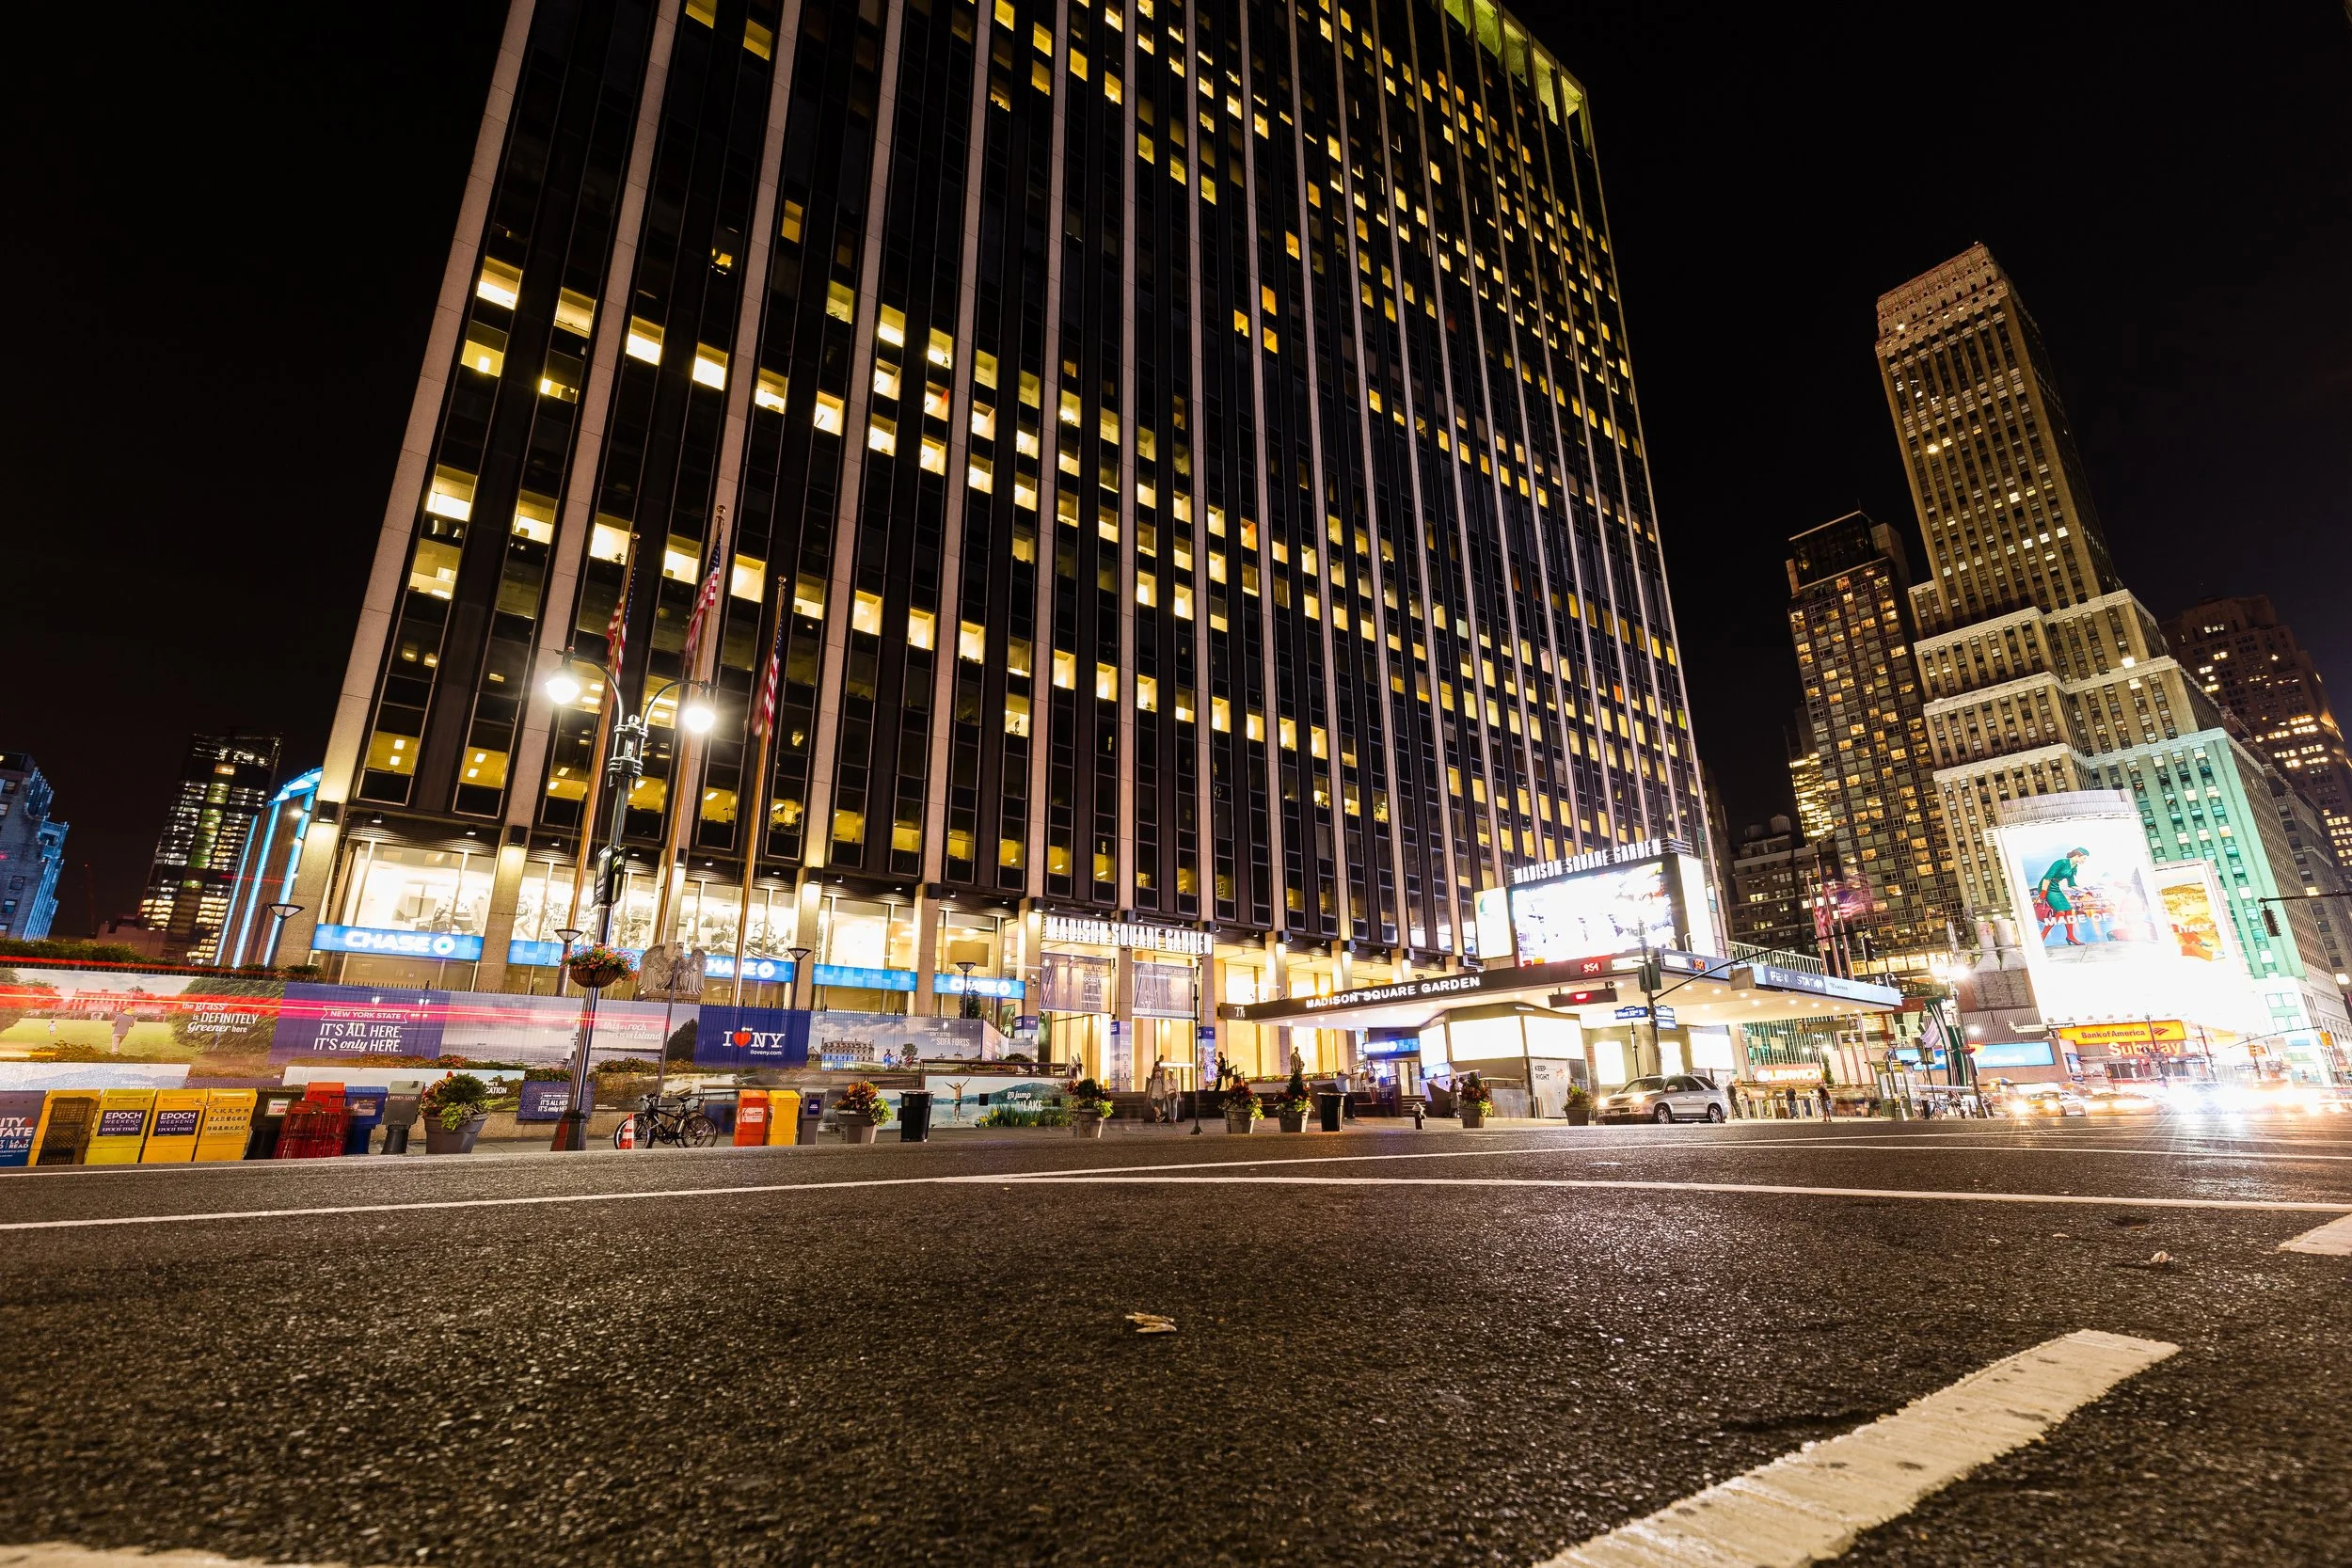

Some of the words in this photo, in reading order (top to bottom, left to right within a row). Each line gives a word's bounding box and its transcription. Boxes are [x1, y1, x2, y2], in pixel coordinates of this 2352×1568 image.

[1514, 860, 1563, 884] MADISON
[1565, 850, 1610, 873] SQUARE
[1613, 839, 1661, 863] GARDEN
[2043, 914, 2087, 927] MADE
[2090, 914, 2110, 924] OF
[1045, 916, 1108, 944] MADISON
[1112, 923, 1162, 952] SQUARE
[1165, 928, 1213, 954] GARDEN
[345, 931, 432, 953] CHASE
[1306, 993, 1359, 1009] MADISON
[1363, 986, 1416, 1001] SQUARE
[1422, 976, 1481, 993] GARDEN
[195, 1003, 226, 1011] grass
[1234, 1006, 1246, 1018] Th
[200, 1012, 259, 1024] DEFINITELY
[187, 1022, 230, 1033] Greener
[320, 1023, 343, 1037] IT'S
[346, 1024, 367, 1037] ALL
[370, 1025, 402, 1038] HERE.
[2111, 1029, 2145, 1037] America
[634, 1031, 661, 1040] island
[723, 1031, 733, 1047] I
[936, 1037, 951, 1046] SOFA
[313, 1037, 338, 1051] IT'S
[340, 1038, 368, 1052] only
[370, 1038, 402, 1052] HERE.
[1015, 1091, 1031, 1100] jump
[1024, 1101, 1042, 1111] LAKE
[0, 1117, 26, 1127] ITY
[0, 1127, 34, 1137] TATE
